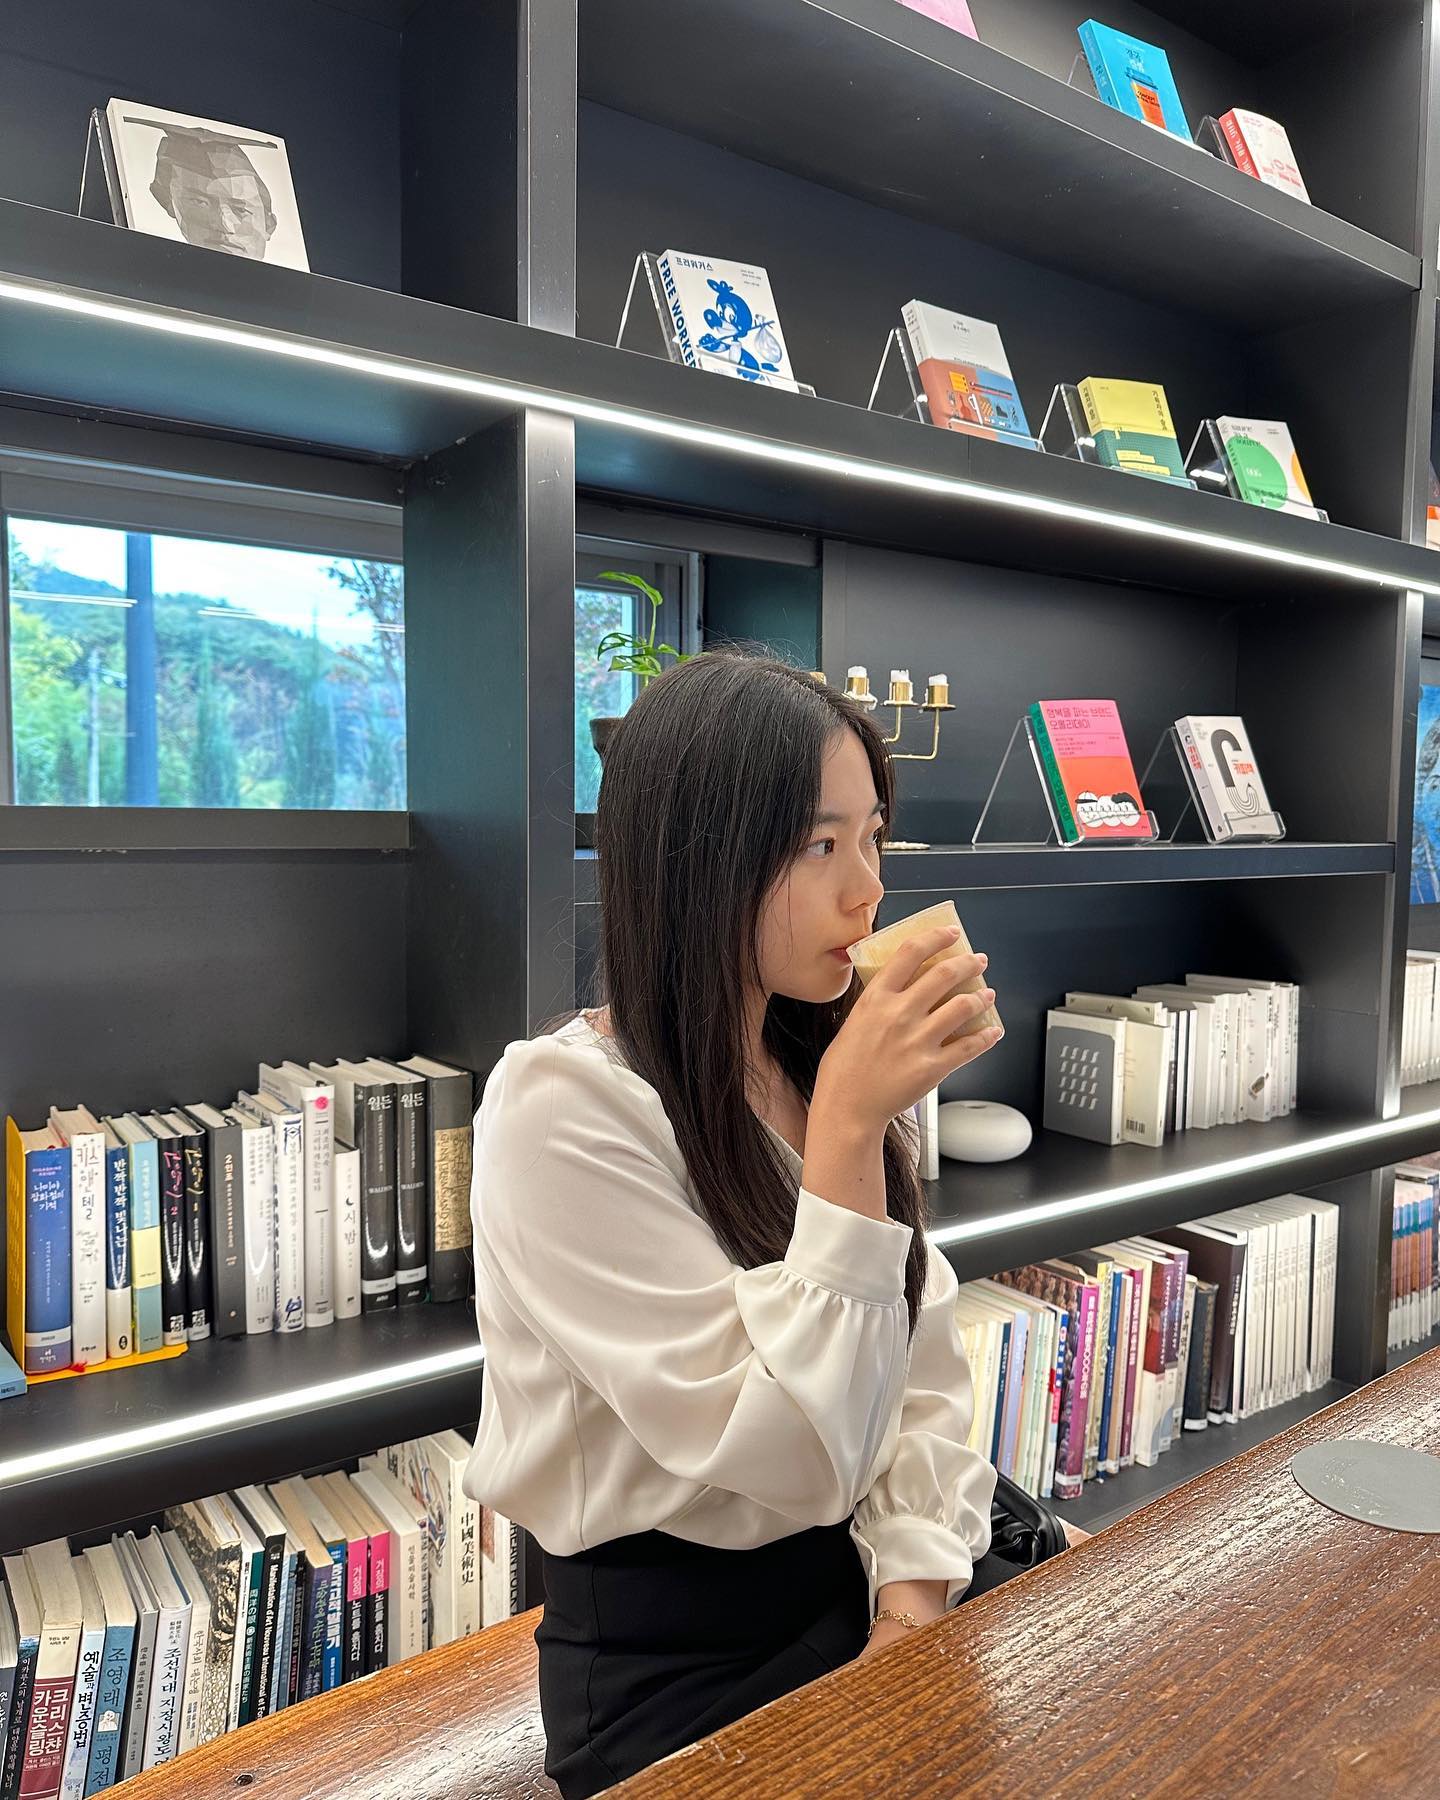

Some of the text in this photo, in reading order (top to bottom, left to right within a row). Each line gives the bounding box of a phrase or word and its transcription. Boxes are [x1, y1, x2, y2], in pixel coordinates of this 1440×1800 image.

[660, 258, 677, 299] FREE
[675, 256, 714, 272] 프리워커스
[367, 1094, 393, 1111] 월든
[400, 1092, 425, 1108] 월든
[33, 1180, 60, 1192] 나미야
[113, 1158, 128, 1208] 반짝반짝
[368, 1185, 393, 1194] WALDEN
[400, 1181, 424, 1190] WALDEN
[39, 1200, 57, 1211] 기적
[461, 1511, 475, 1586] 中國美術史
[17, 1657, 31, 1698] 이카루스의
[161, 1647, 182, 1693] 조선시대
[14, 1700, 25, 1724] 날개로
[73, 1650, 100, 1749] 예술과 변증법
[91, 1647, 129, 1787] 조영래 평전
[29, 1690, 52, 1757] 카운슬링
[45, 1688, 69, 1754] 크리스챤
[153, 1695, 175, 1757] 지장시왕도
[5, 1772, 14, 1789] 날다
